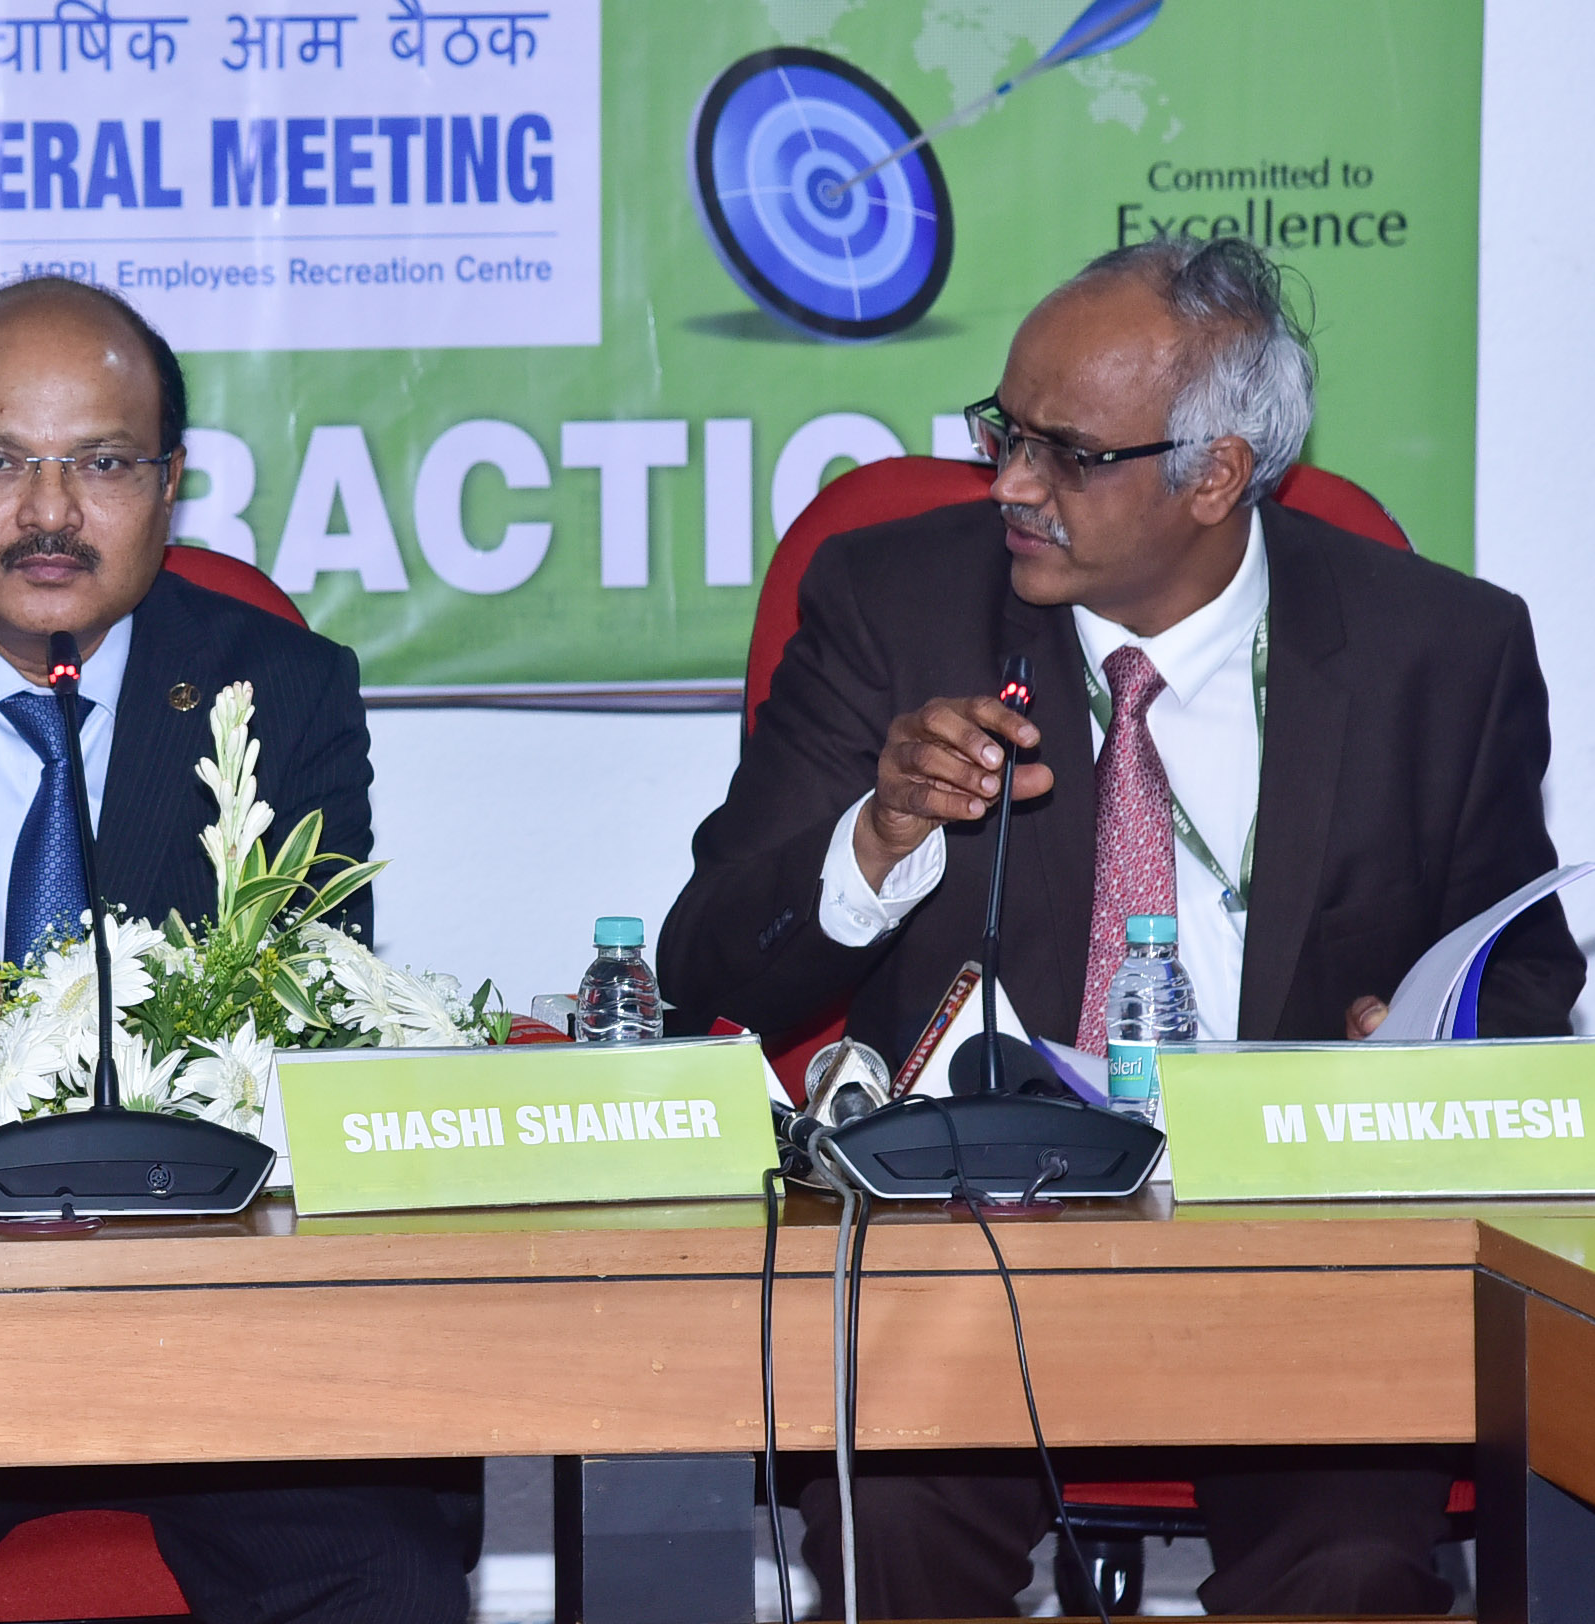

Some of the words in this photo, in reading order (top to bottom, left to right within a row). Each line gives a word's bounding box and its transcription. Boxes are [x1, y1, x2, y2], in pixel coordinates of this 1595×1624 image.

[221, 14, 357, 70] आम
[389, 0, 549, 68] बैठक
[212, 112, 554, 206] MEETING
[1148, 156, 1330, 192] Committed
[1342, 162, 1373, 188] to
[1118, 197, 1408, 249] Excellence
[117, 260, 275, 291] Employees
[289, 257, 444, 284] Recreation
[455, 254, 553, 282] Centre
[1256, 612, 1268, 655] RPL
[1109, 1055, 1143, 1076] isleri
[342, 1107, 505, 1153] SHASHI
[516, 1100, 721, 1146] SHANKER
[1262, 1105, 1307, 1143] M
[1315, 1098, 1585, 1143] VENKATESH
